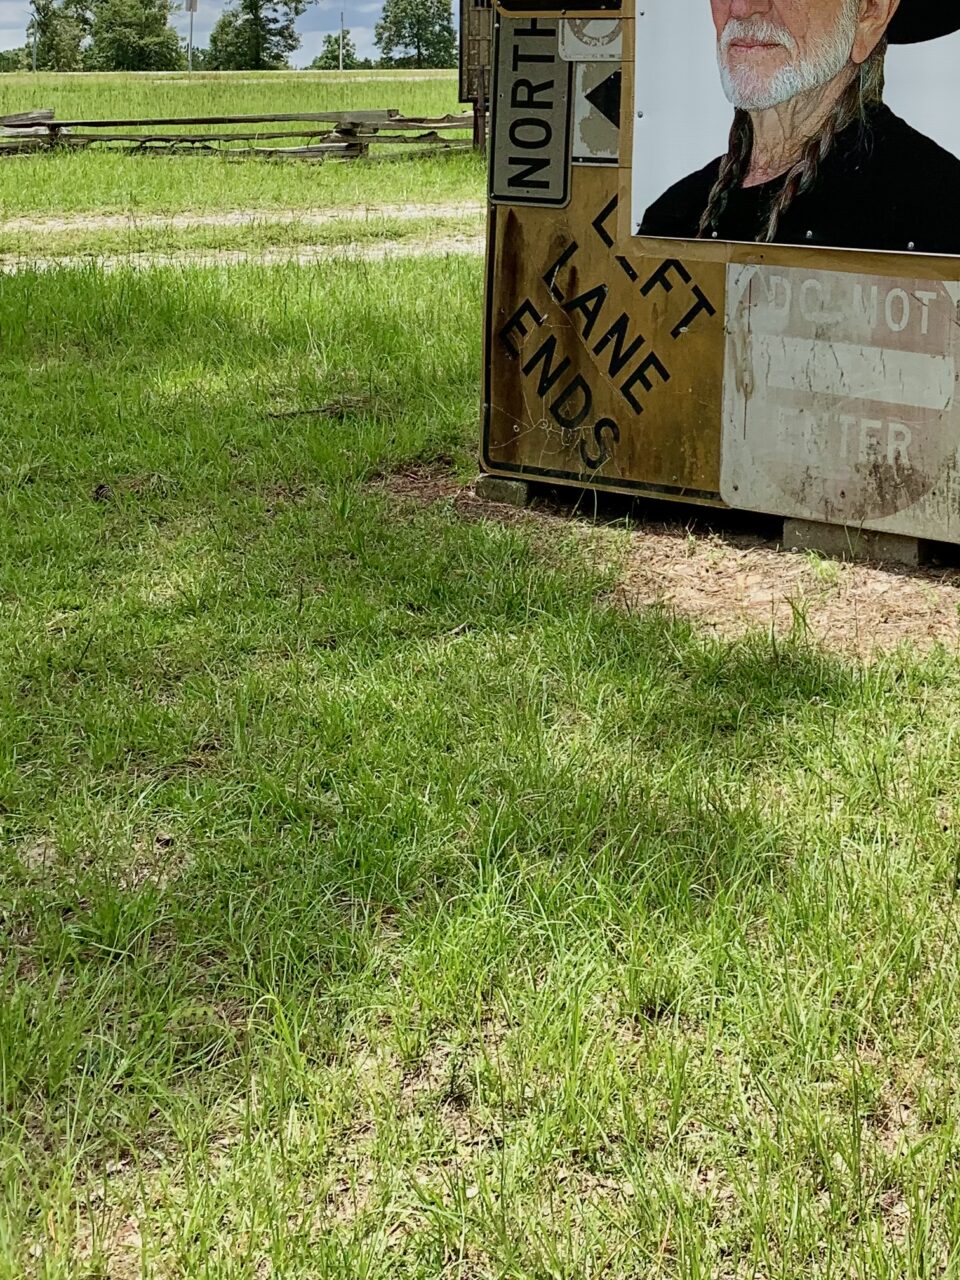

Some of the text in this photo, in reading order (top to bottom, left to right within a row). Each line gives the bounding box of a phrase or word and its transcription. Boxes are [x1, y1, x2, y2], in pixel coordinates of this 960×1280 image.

[507, 18, 556, 189] NORTH
[542, 240, 671, 416] LANE
[592, 193, 717, 340] LFT
[852, 282, 937, 335] NOT
[499, 298, 620, 470] ENDS
